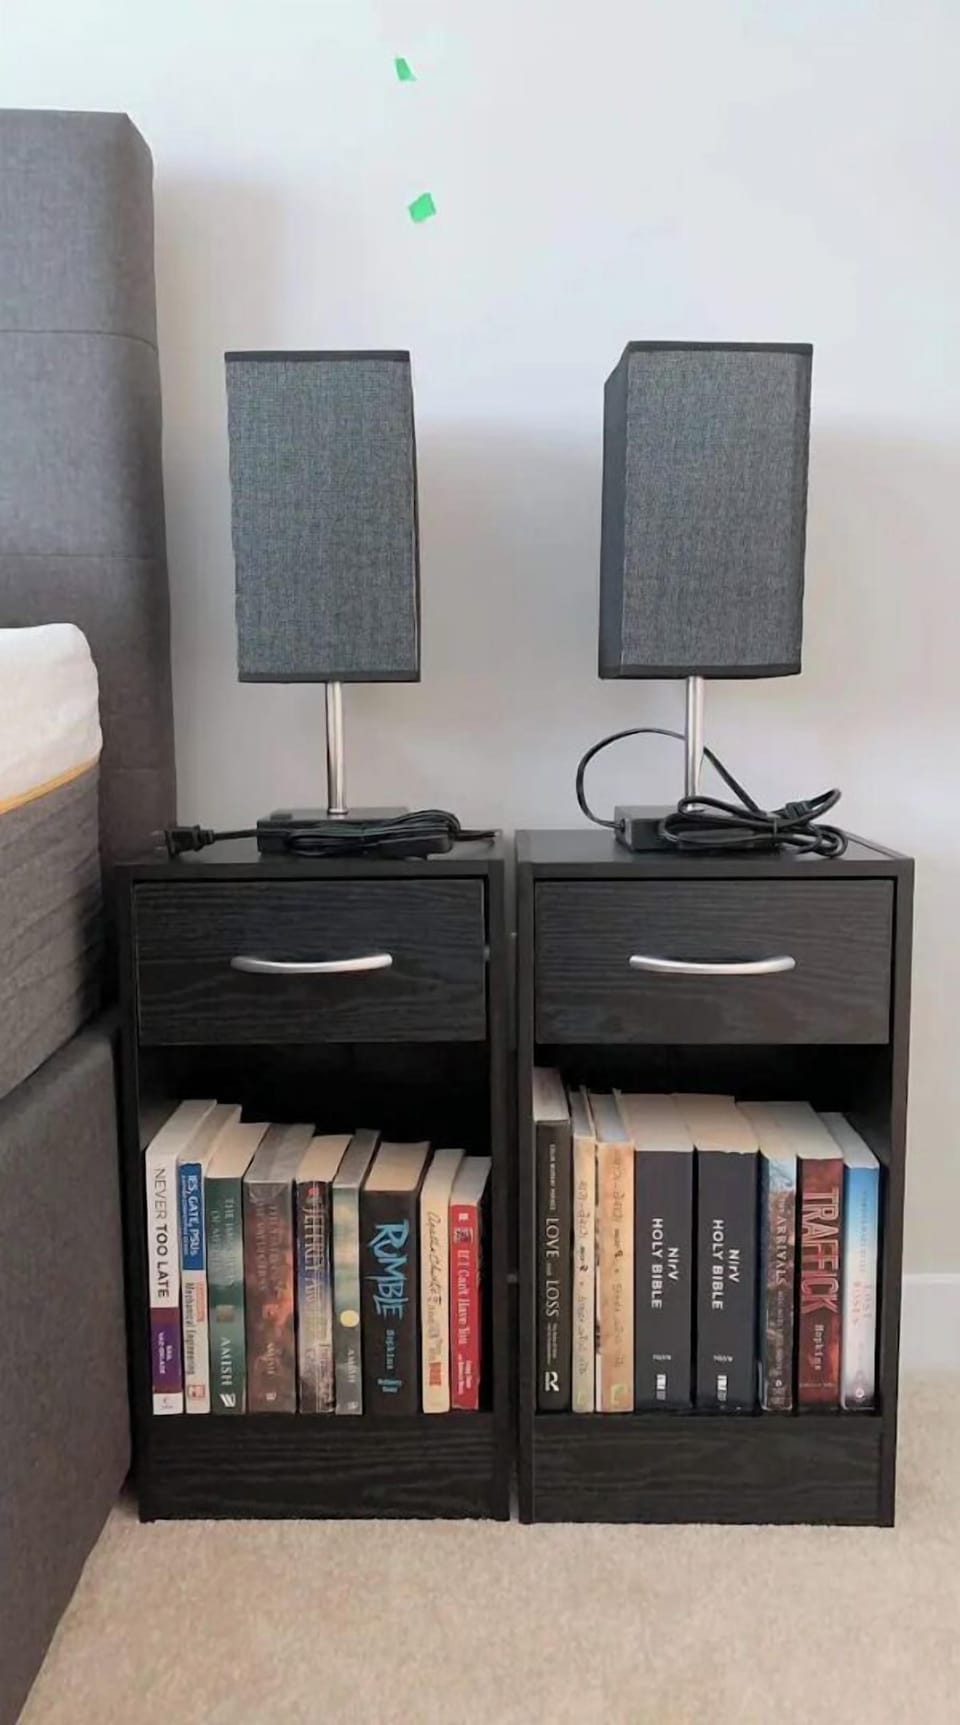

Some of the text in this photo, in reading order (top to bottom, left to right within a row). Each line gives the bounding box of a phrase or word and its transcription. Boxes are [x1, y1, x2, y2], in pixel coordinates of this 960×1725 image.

[153, 1168, 170, 1298] NEVER TOO LATE
[186, 1175, 201, 1256] IES, GATE, PSUs
[302, 1208, 325, 1273] JEFFREY
[546, 1218, 560, 1259] LOVE
[652, 1218, 663, 1310] HOLY BIBLE
[712, 1219, 724, 1311] HOLY BIBLE
[776, 1215, 787, 1286] ARRIVALS
[801, 1187, 840, 1314] TRAFFICK
[458, 1269, 470, 1295] Can't
[546, 1280, 560, 1317] LOSS
[458, 1299, 470, 1325] Have
[458, 1327, 470, 1345] You
[221, 1337, 232, 1386] AMISH
[813, 1324, 825, 1371] Hopkins
